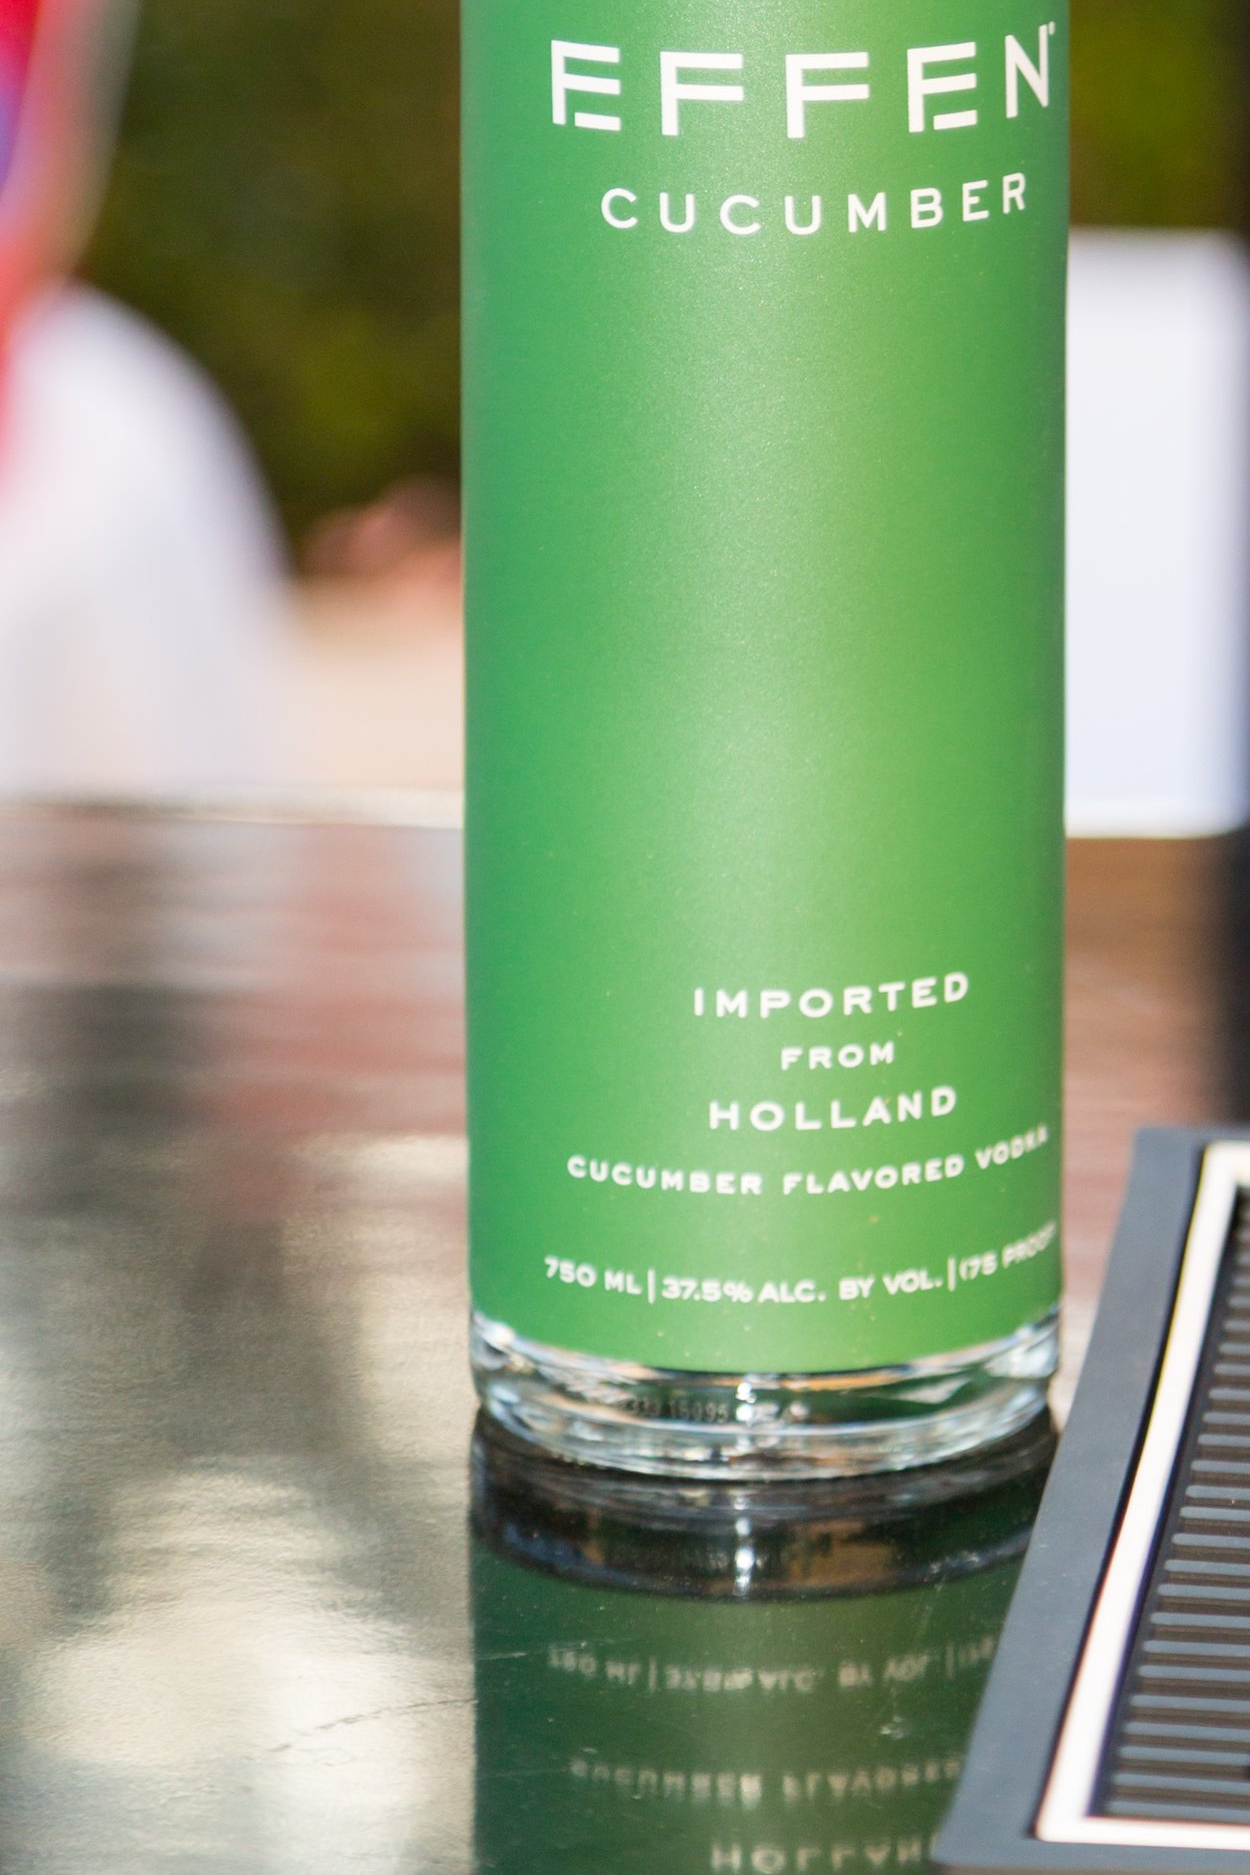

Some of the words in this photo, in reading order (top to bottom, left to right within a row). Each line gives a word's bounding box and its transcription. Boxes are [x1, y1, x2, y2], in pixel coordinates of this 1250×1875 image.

[551, 24, 1050, 139] EFFEN
[600, 172, 1026, 236] CUCUMBER
[693, 972, 969, 1019] IMPORTED
[780, 1041, 895, 1071] FROM
[708, 1086, 957, 1132] HOLLAND
[566, 1155, 763, 1196] CUCUMBER
[782, 1154, 965, 1195] FLAVORED
[544, 1256, 598, 1288] 750
[604, 1268, 643, 1296] ML
[838, 1277, 876, 1301] BY
[882, 1268, 944, 1296] VOL.
